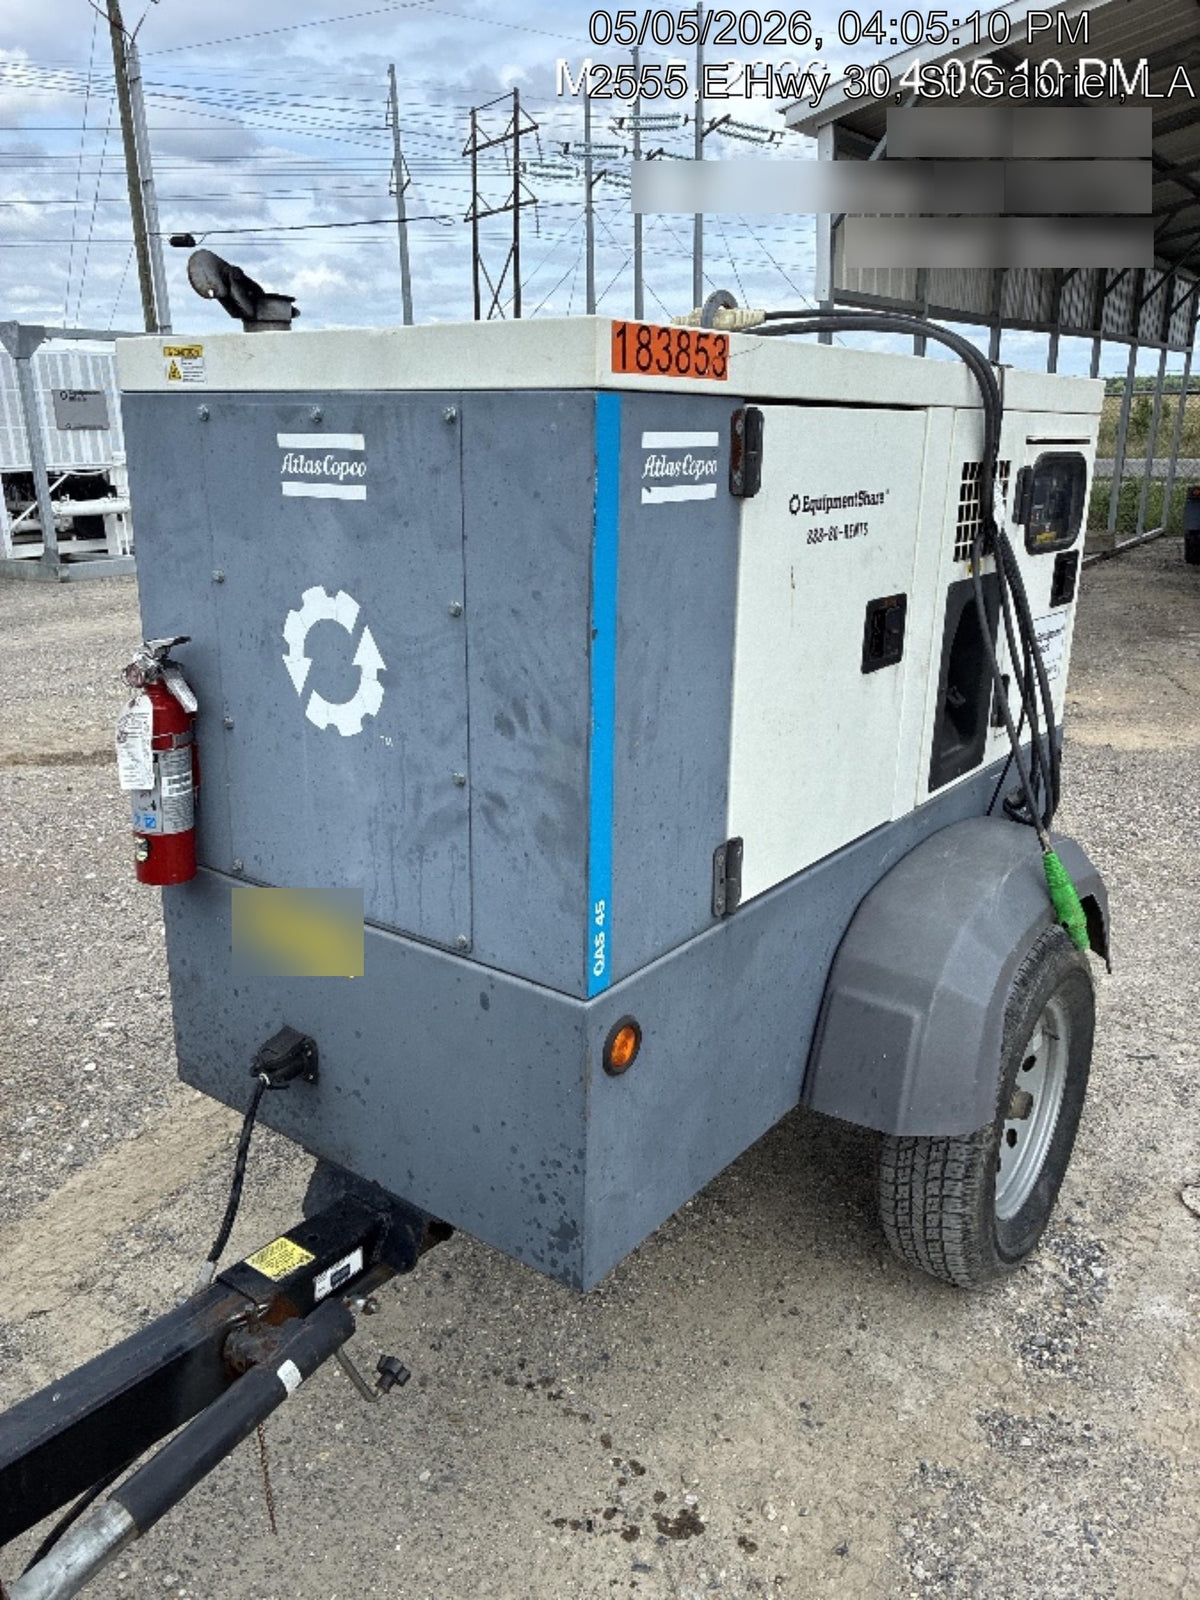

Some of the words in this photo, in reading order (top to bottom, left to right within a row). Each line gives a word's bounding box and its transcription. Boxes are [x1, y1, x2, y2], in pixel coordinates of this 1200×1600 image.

[616, 322, 726, 378] 183853
[801, 489, 885, 516] EquipmentShare
[594, 899, 606, 927] 45
